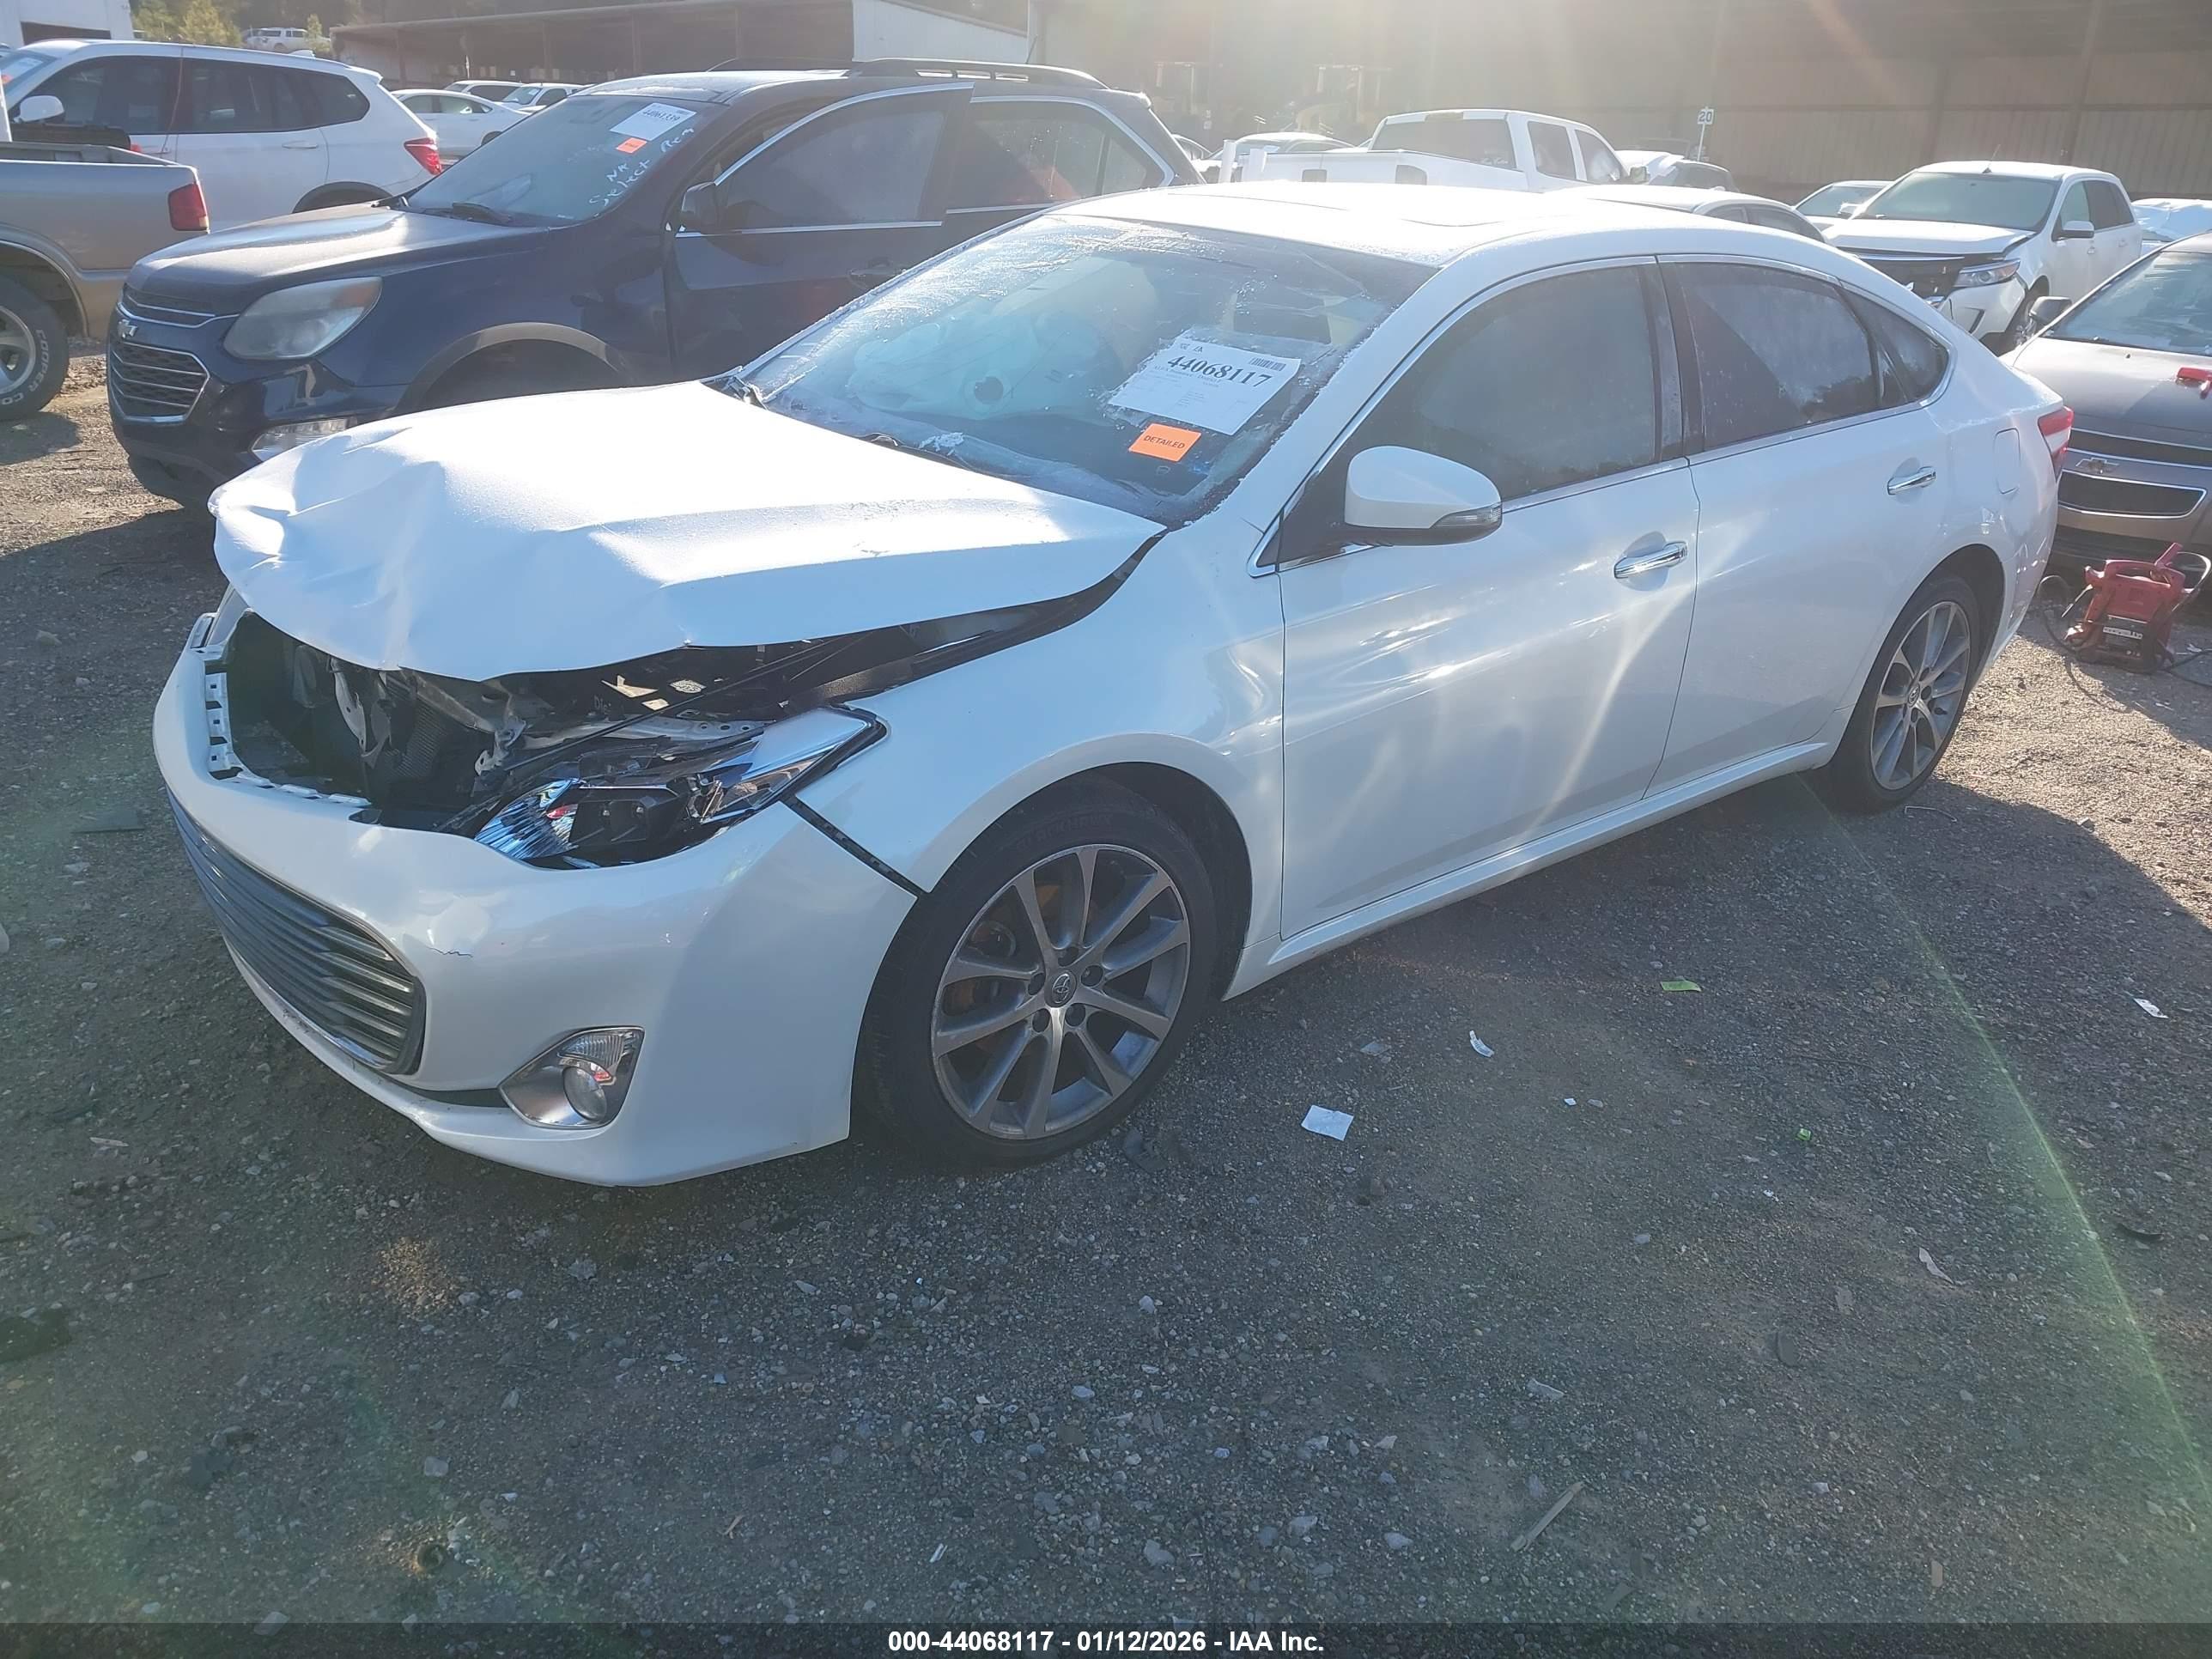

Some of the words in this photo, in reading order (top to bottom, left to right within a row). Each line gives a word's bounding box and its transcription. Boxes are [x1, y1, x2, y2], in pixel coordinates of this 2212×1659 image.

[1698, 112, 1712, 122] 20
[28, 329, 49, 392] COOPER
[1167, 356, 1273, 387] 44068117
[1143, 434, 1186, 450] DETAILED
